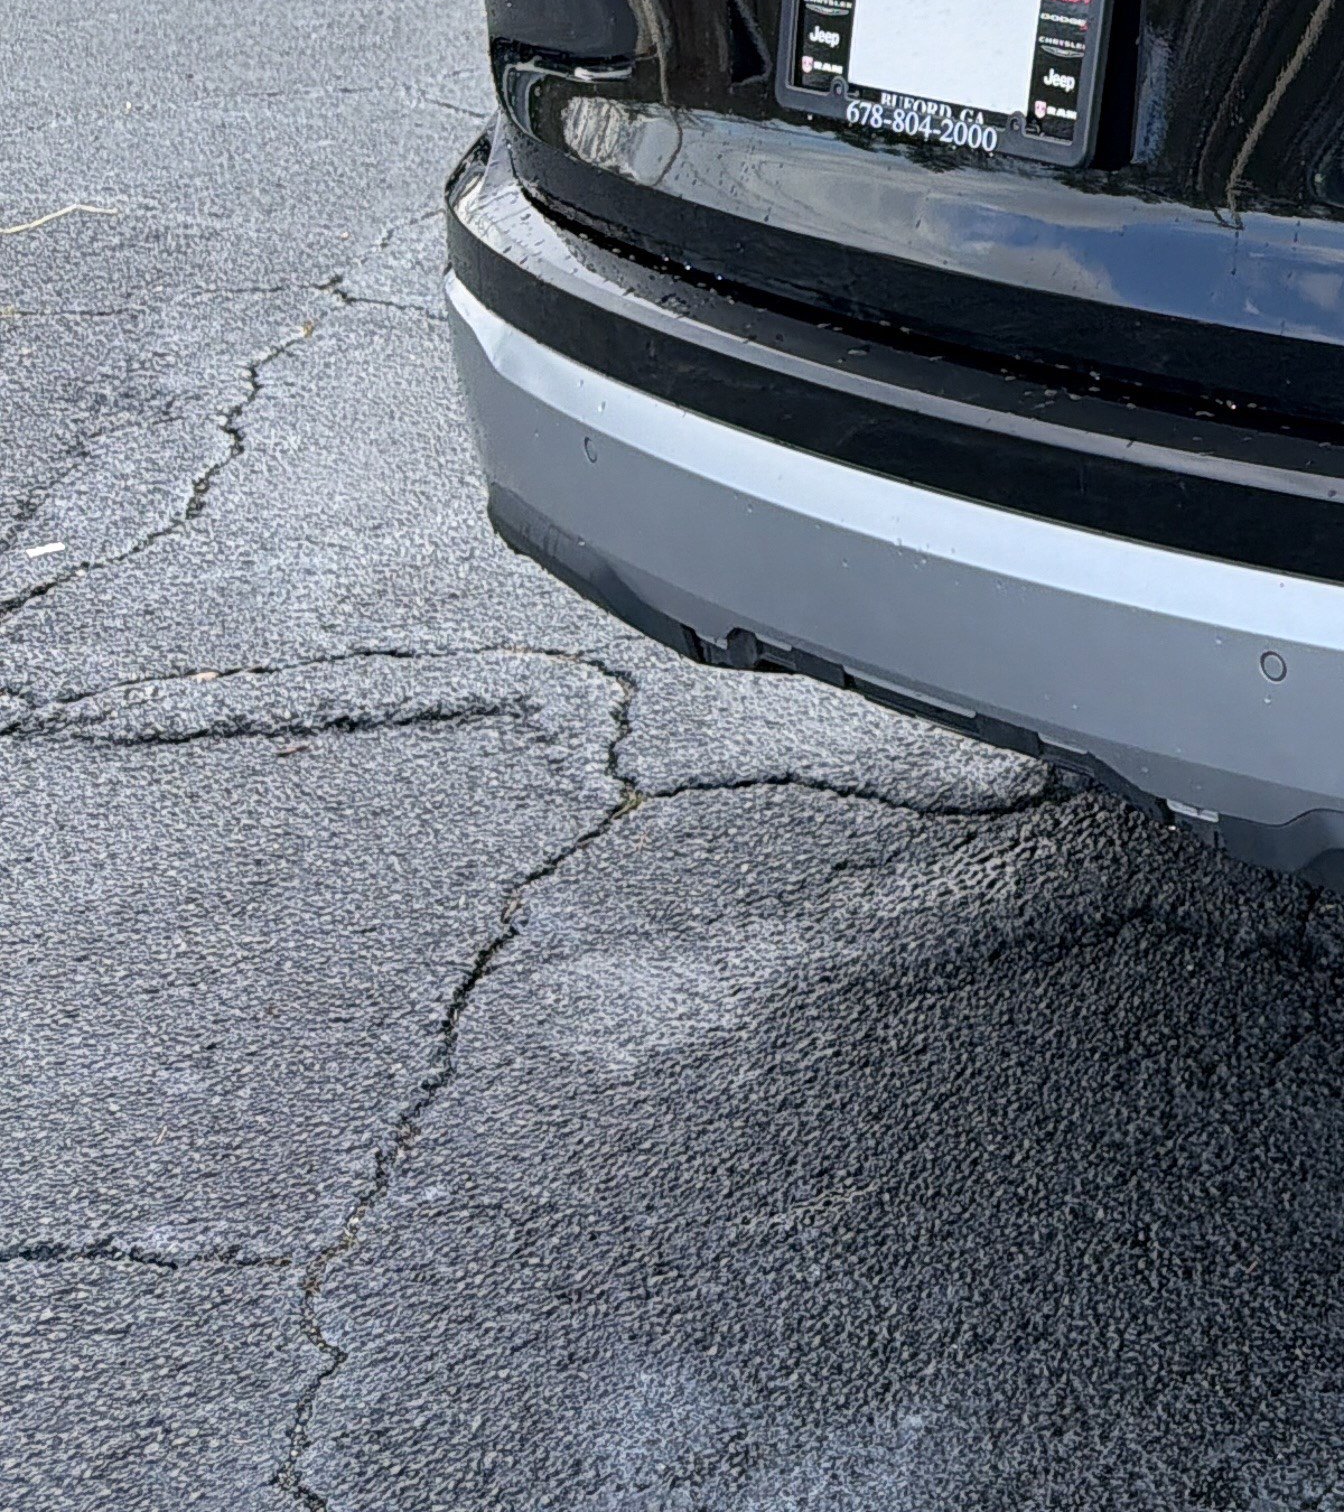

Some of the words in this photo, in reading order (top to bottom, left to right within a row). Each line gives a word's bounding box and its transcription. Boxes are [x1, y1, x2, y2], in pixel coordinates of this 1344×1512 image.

[1040, 12, 1087, 27] DODGE
[809, 25, 840, 48] Jeep
[813, 60, 843, 75] RAM
[1043, 68, 1076, 93] Jeep
[960, 108, 984, 125] GA
[1046, 105, 1077, 121] RAM
[846, 100, 998, 152] 678-804-2000
